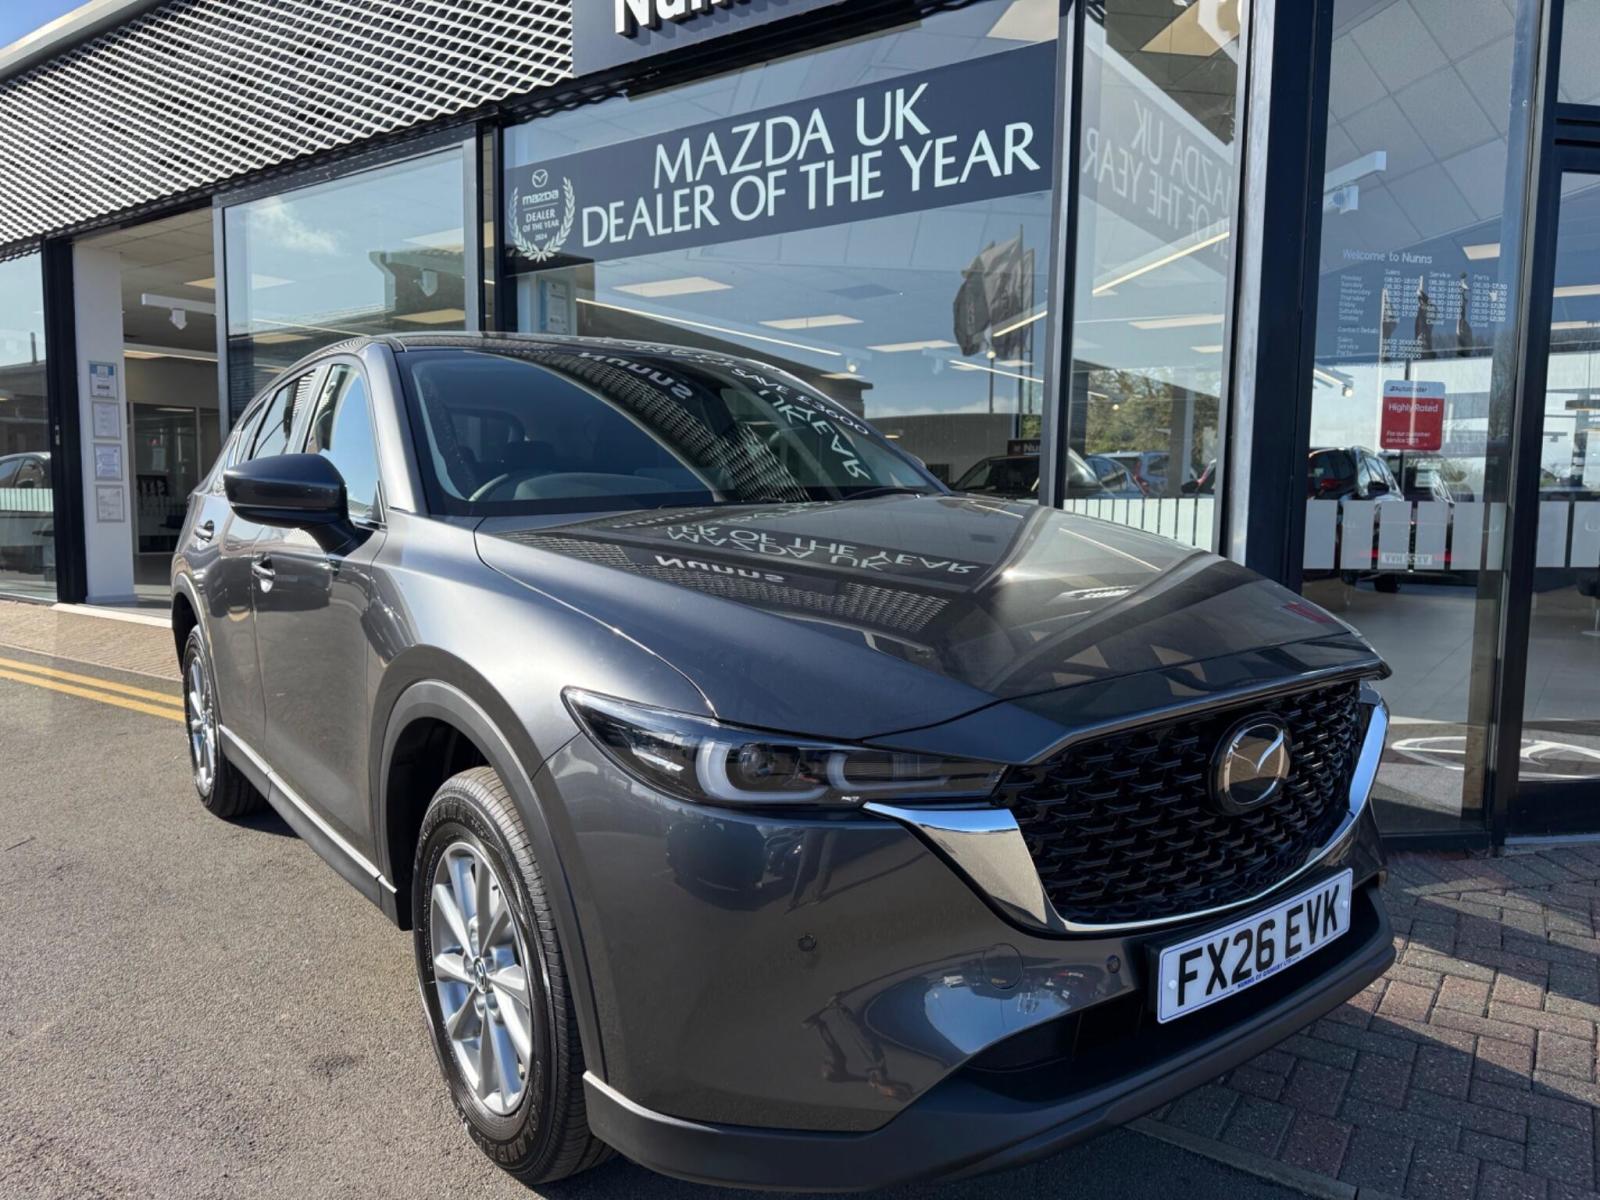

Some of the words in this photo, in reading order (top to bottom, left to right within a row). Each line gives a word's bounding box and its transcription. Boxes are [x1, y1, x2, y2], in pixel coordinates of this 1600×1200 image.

[653, 107, 834, 189] MAZDA
[856, 83, 930, 147] UK
[581, 184, 719, 248] DEALER
[730, 169, 787, 222] OF
[800, 150, 884, 210] THE
[899, 121, 1041, 192] YEAR
[525, 208, 556, 223] DEALER
[522, 224, 531, 233] OF
[532, 222, 543, 231] THE
[544, 219, 560, 229] YEAR
[1342, 248, 1385, 262] Welcome
[1388, 251, 1400, 262] to
[1402, 252, 1433, 264] Nunns
[1414, 403, 1439, 413] Rated
[1177, 918, 1276, 1007] FX26
[1284, 884, 1340, 959] EVK
